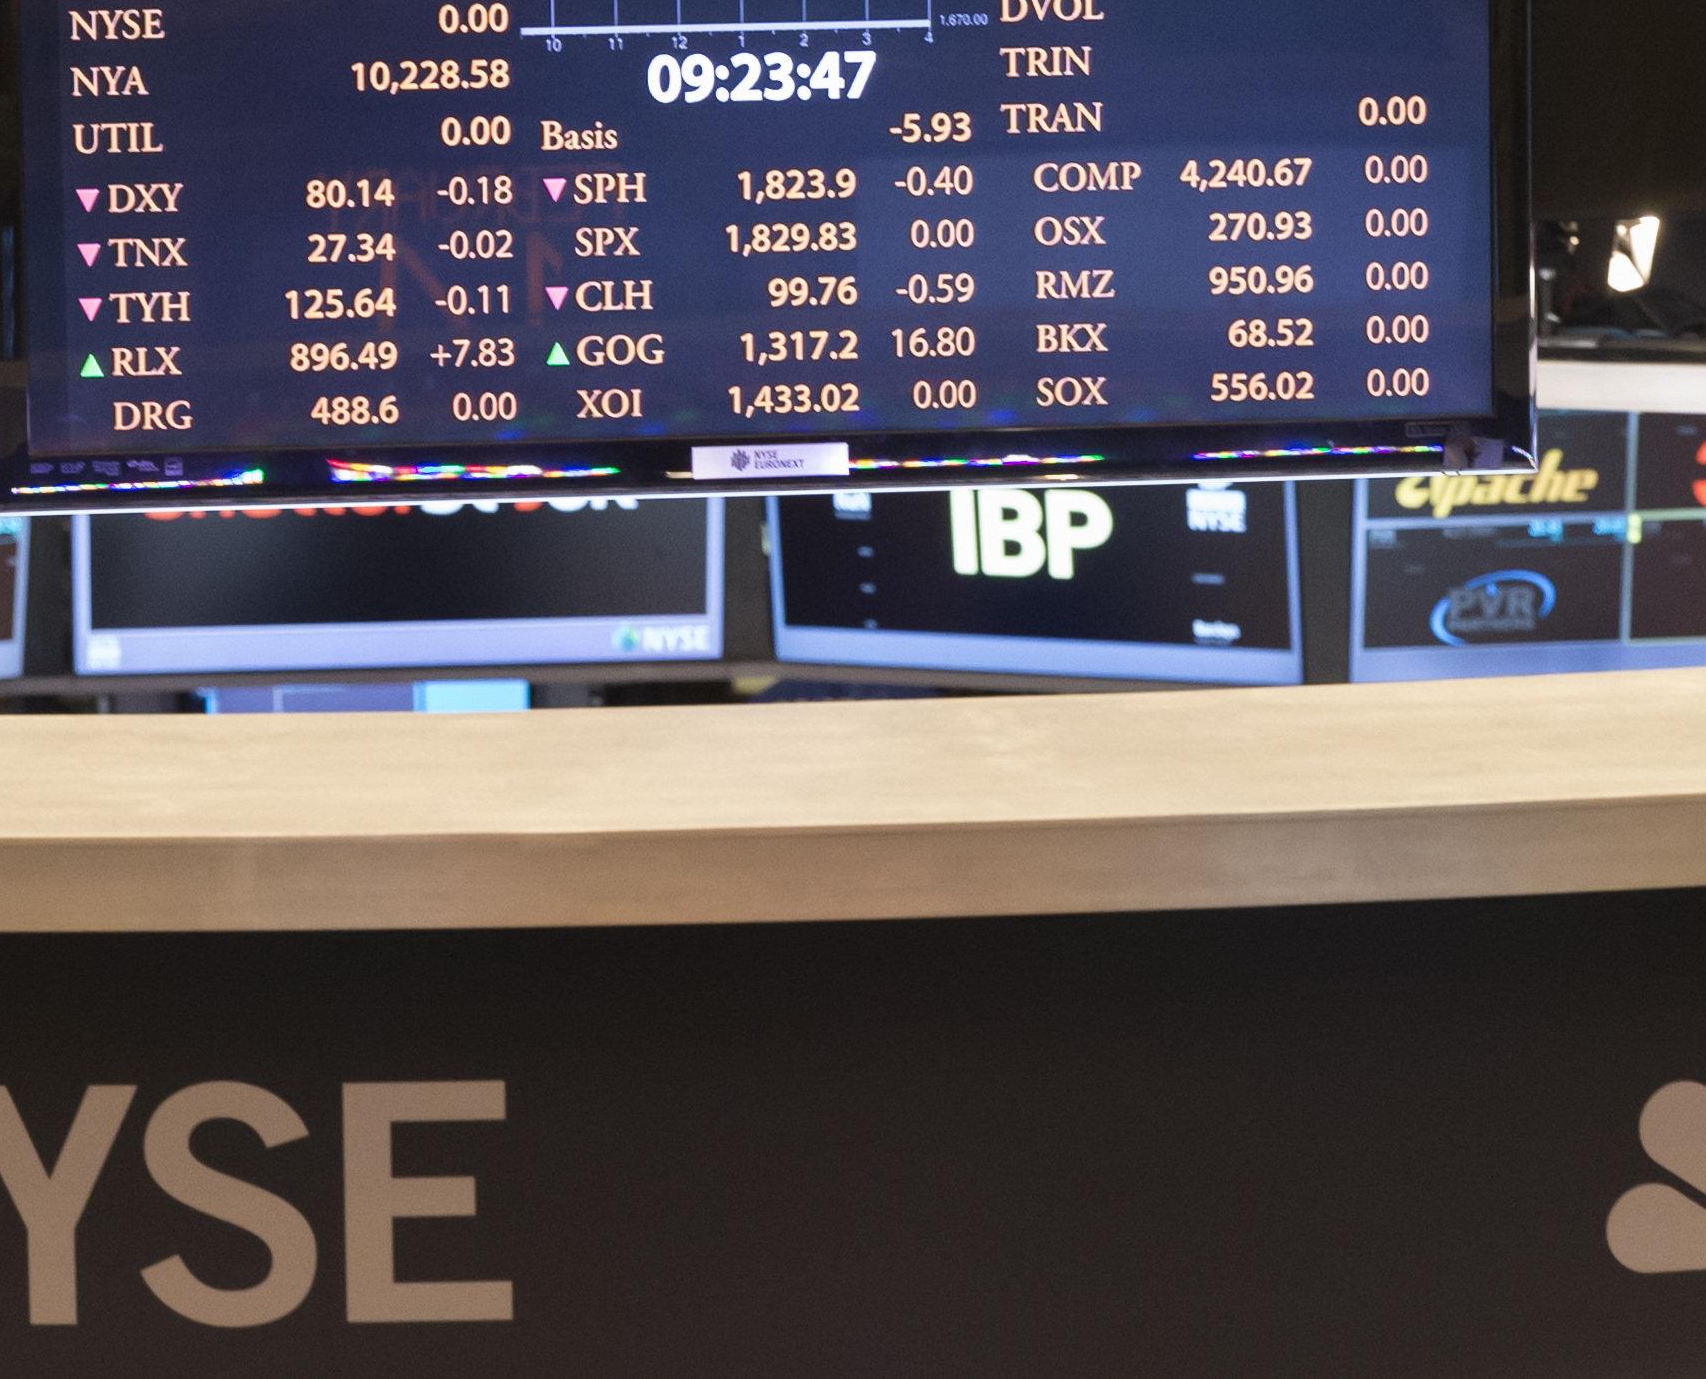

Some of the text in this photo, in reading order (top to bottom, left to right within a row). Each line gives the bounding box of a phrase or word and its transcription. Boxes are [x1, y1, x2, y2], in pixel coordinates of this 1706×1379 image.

[68, 2, 509, 41] NYSE 0.00
[937, 13, 987, 27] 1,670.00
[69, 58, 511, 97] NYA 10,228.58
[646, 49, 877, 104] 09:23:47
[999, 45, 1092, 78] TRIN
[540, 111, 972, 151] Basis -5.93
[999, 95, 1427, 134] TRAN 0.00
[72, 115, 512, 155] UTIL 0.00
[573, 164, 974, 205] SPH 1,823.9 -0.40
[1033, 154, 1428, 193] COMP 4,240.67 0.00
[107, 175, 514, 214] DXY 80.14 -0.18
[574, 218, 975, 258] SPX 1,829.83 0.00
[1034, 207, 1429, 246] OSX 270.93 0.00
[107, 229, 514, 268] TNX 27.34 -0.02
[575, 272, 975, 312] CLH 99.76 -0.59
[1035, 261, 1429, 299] RMZ 950.96 0.00
[108, 284, 509, 324] TYH 125.64 -0.11
[576, 326, 976, 367] GOG 1,317.2 16.80
[1036, 314, 1430, 353] BKX 68.52 0.00
[111, 337, 516, 377] RLX 896.49 +7.83
[576, 379, 977, 419] XOI 1,433.02 0.00
[1036, 367, 1430, 407] SOX 556.02 0.00
[113, 391, 518, 431] DRG 488.6 0.00
[950, 489, 1113, 579] IBP
[642, 625, 711, 651] NYSE
